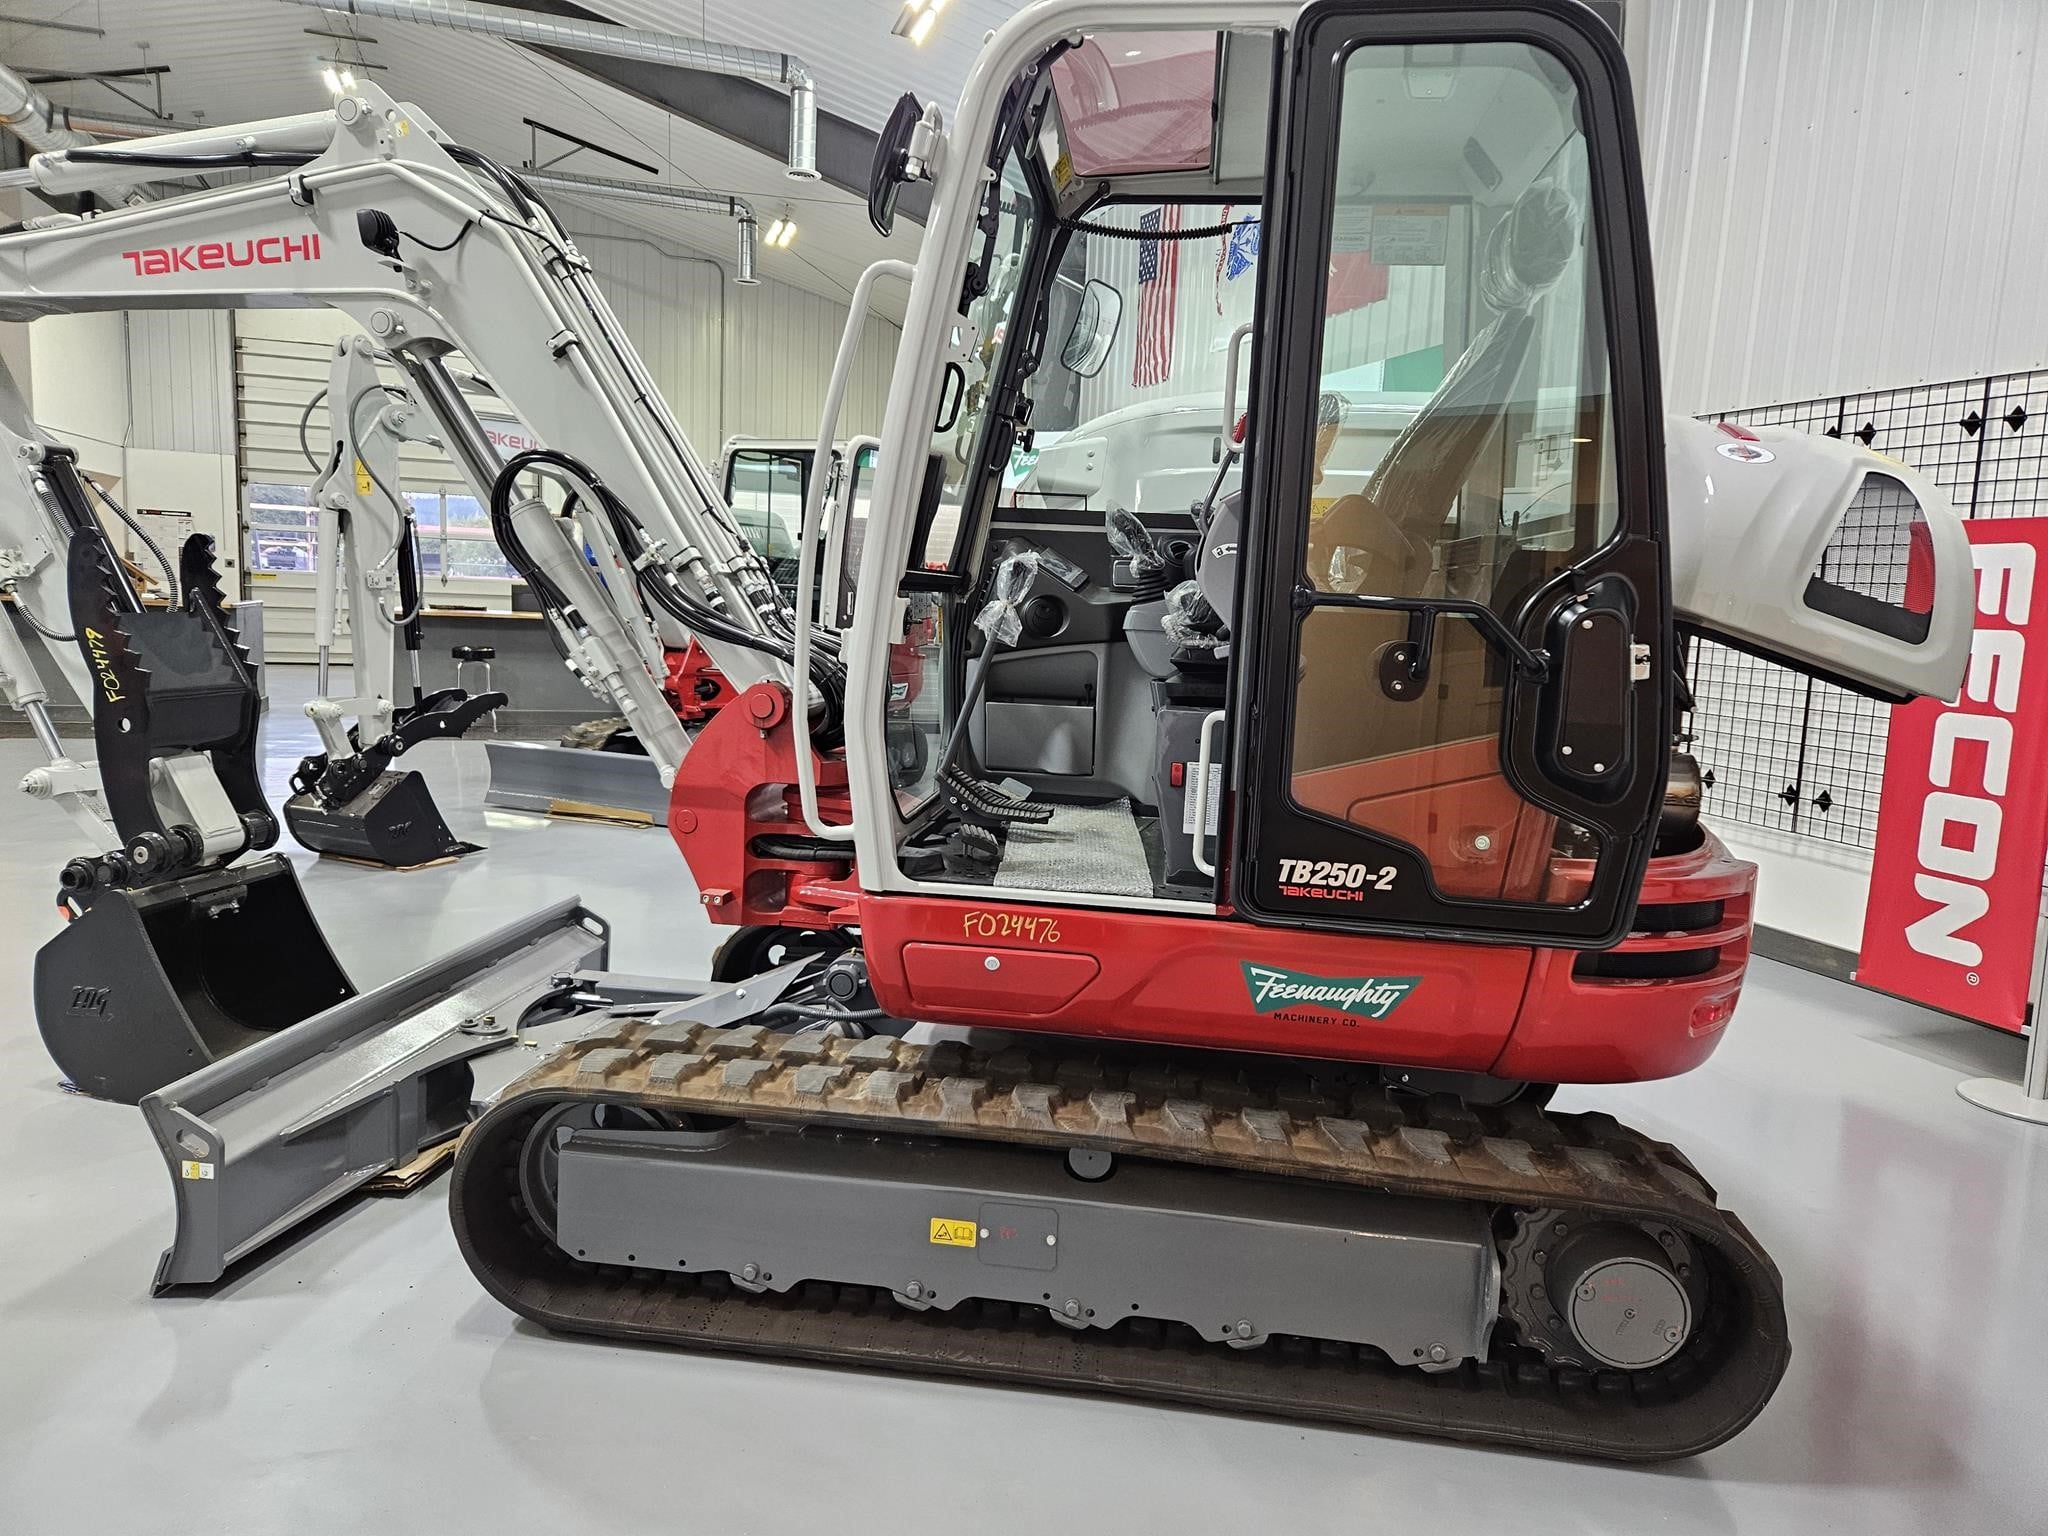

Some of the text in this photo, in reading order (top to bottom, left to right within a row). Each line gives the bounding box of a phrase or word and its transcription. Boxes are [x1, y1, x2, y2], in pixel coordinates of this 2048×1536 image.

[122, 233, 321, 277] TAKEUCHI
[1904, 542, 2037, 967] FECON
[1278, 859, 1398, 891] TB250-2
[1278, 885, 1364, 902] TAKEUCHI
[1250, 967, 1409, 1018] Feenaughty
[1273, 1012, 1361, 1028] MACHINERY CO.
